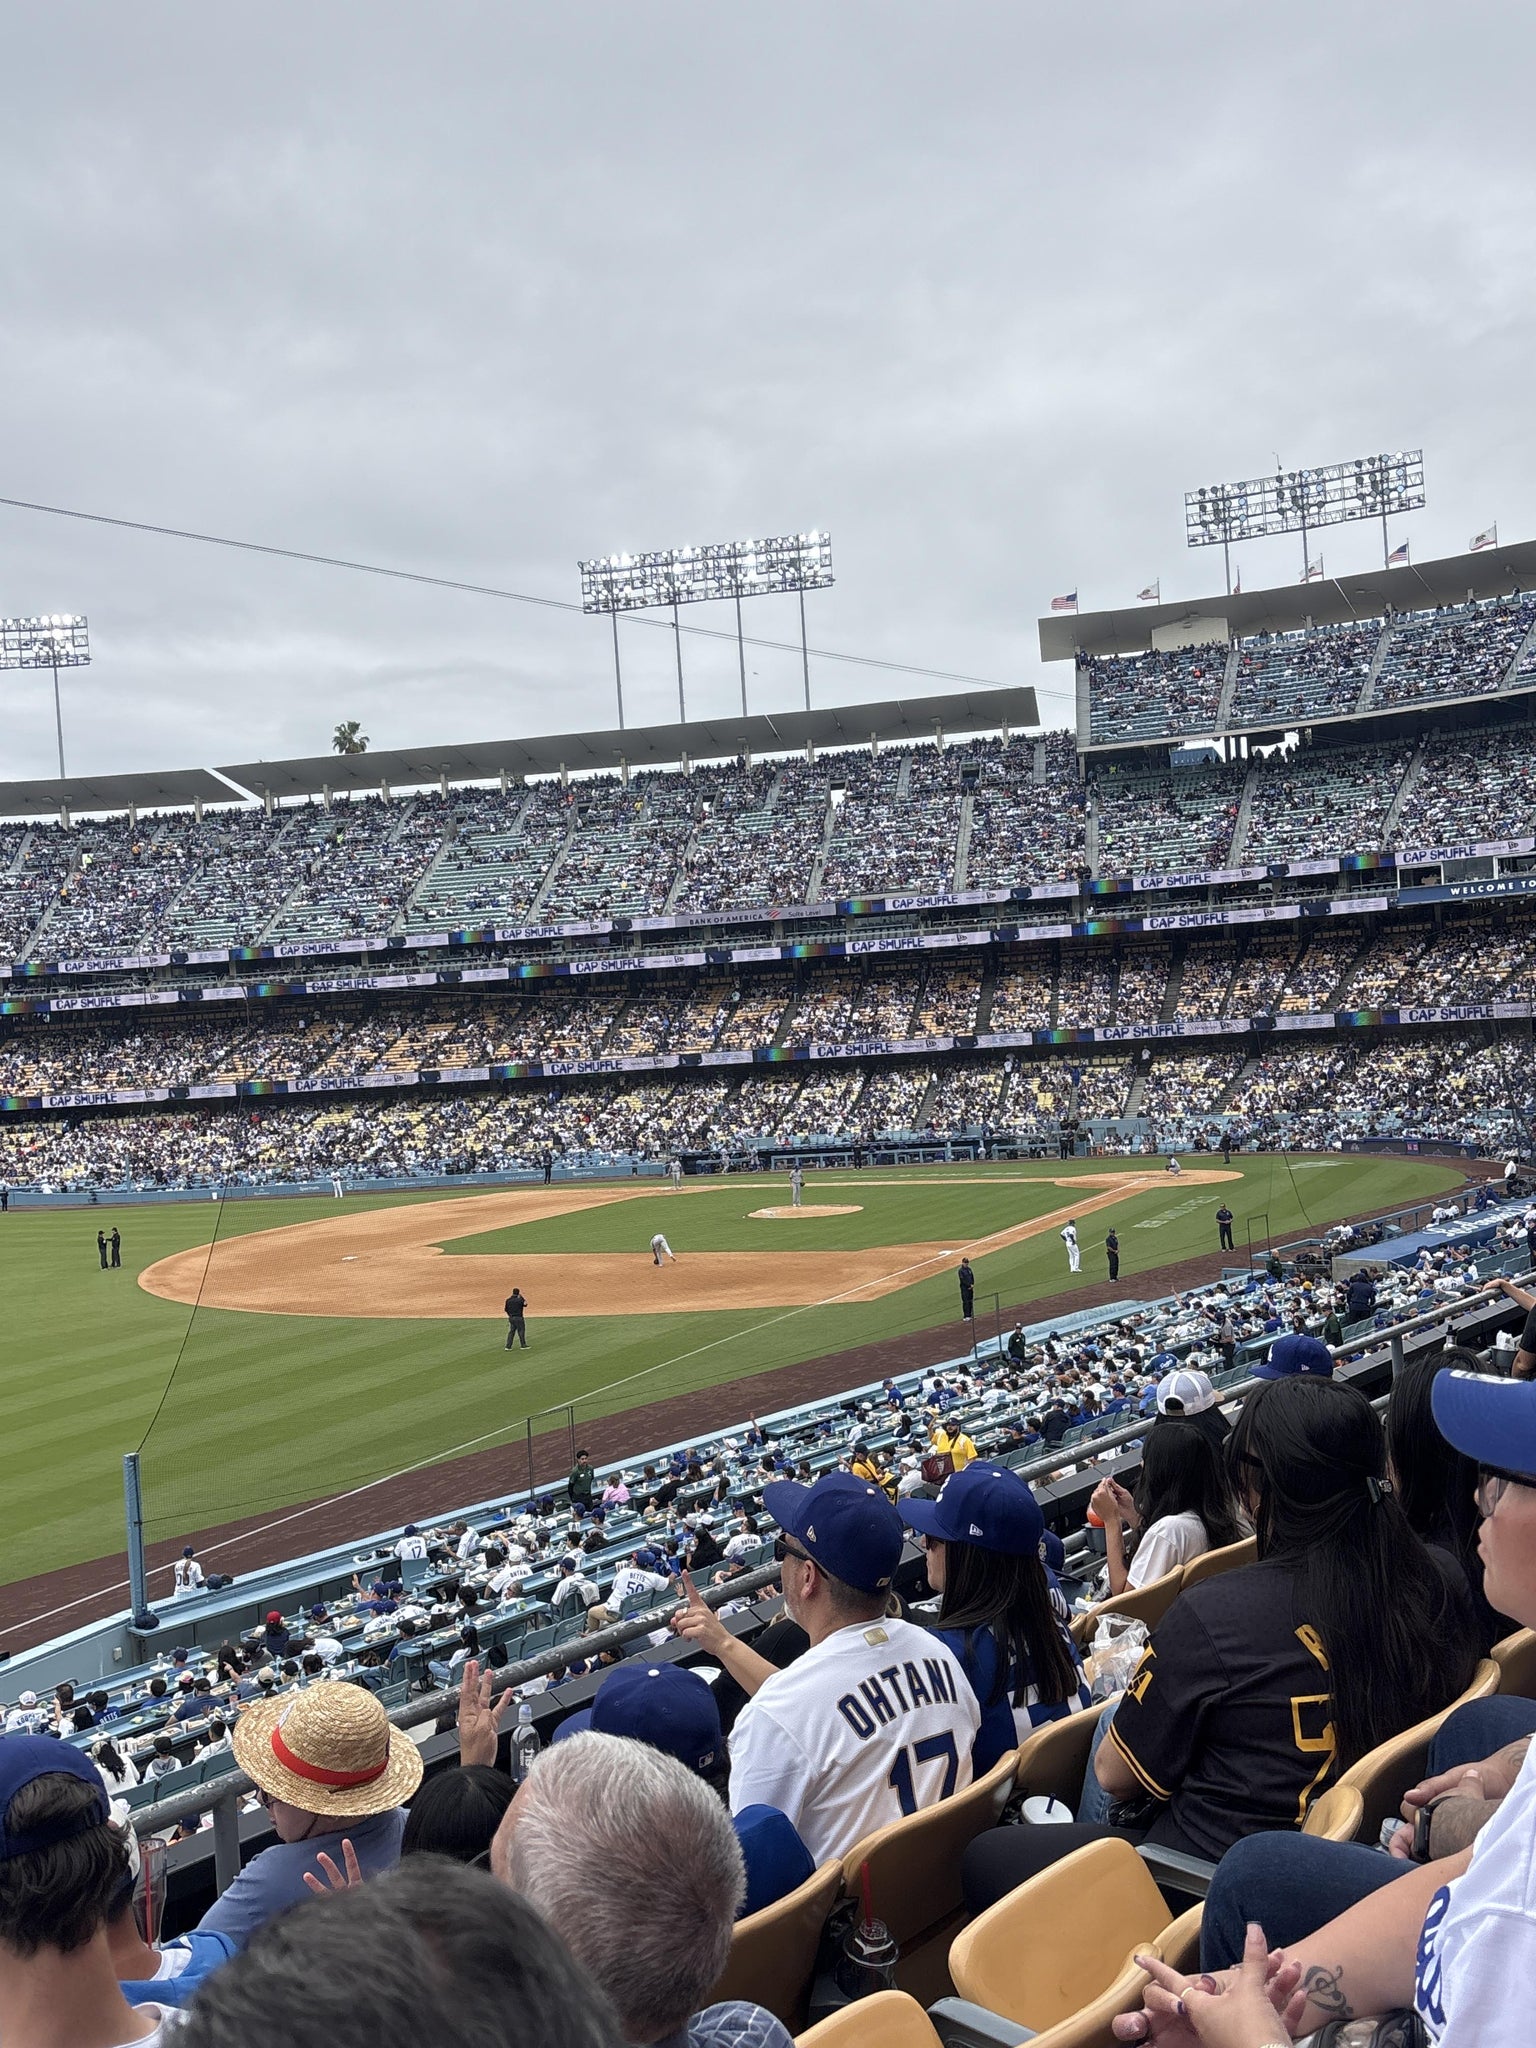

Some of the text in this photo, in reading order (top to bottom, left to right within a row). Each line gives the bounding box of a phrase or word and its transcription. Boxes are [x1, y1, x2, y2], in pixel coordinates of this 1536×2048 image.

[1403, 851, 1427, 863] CAP
[1430, 846, 1476, 860] SHUFFLE
[1141, 878, 1163, 888] CAP
[1167, 873, 1211, 886] SHUFFLE
[1450, 880, 1536, 895] WELCOME TO
[892, 899, 913, 909] CAP
[916, 895, 958, 906] SHUFFLE
[725, 913, 763, 923] AMERICA
[1150, 912, 1229, 928] CAP SHUFFLE
[502, 930, 522, 939] CAP
[525, 926, 563, 937] SHUFFLE
[280, 946, 300, 955] CAP
[302, 943, 340, 953] SHUFFLE
[852, 941, 875, 952] CAP
[879, 937, 924, 950] SHUFFLE
[65, 962, 84, 971] CAP
[87, 959, 124, 970] SHUFFLE
[576, 962, 598, 972] CAP
[601, 959, 645, 970] SHUFFLE
[312, 982, 333, 991] CAP
[337, 979, 378, 989] SHUFFLE
[56, 1000, 77, 1009] CAP
[81, 996, 121, 1007] SHUFFLE
[1409, 1009, 1436, 1021] CAP
[1441, 1006, 1494, 1019] SHUFFLE
[1103, 1028, 1129, 1039] CAP
[1133, 1024, 1184, 1037] SHUFFLE
[818, 1046, 841, 1057] CAP
[845, 1043, 893, 1055] SHUFFLE
[551, 1063, 574, 1074] CAP
[578, 1060, 622, 1072] SHUFFLE
[295, 1077, 364, 1090] CAP SHUFFLE
[50, 1096, 71, 1106] CAP
[75, 1093, 117, 1104] SHUFFLE
[411, 1545, 421, 1559] 17
[629, 1572, 646, 1582] BETTS
[626, 1581, 644, 1595] 50
[836, 1658, 958, 1741] OHTANI
[887, 1729, 959, 1817] 17
